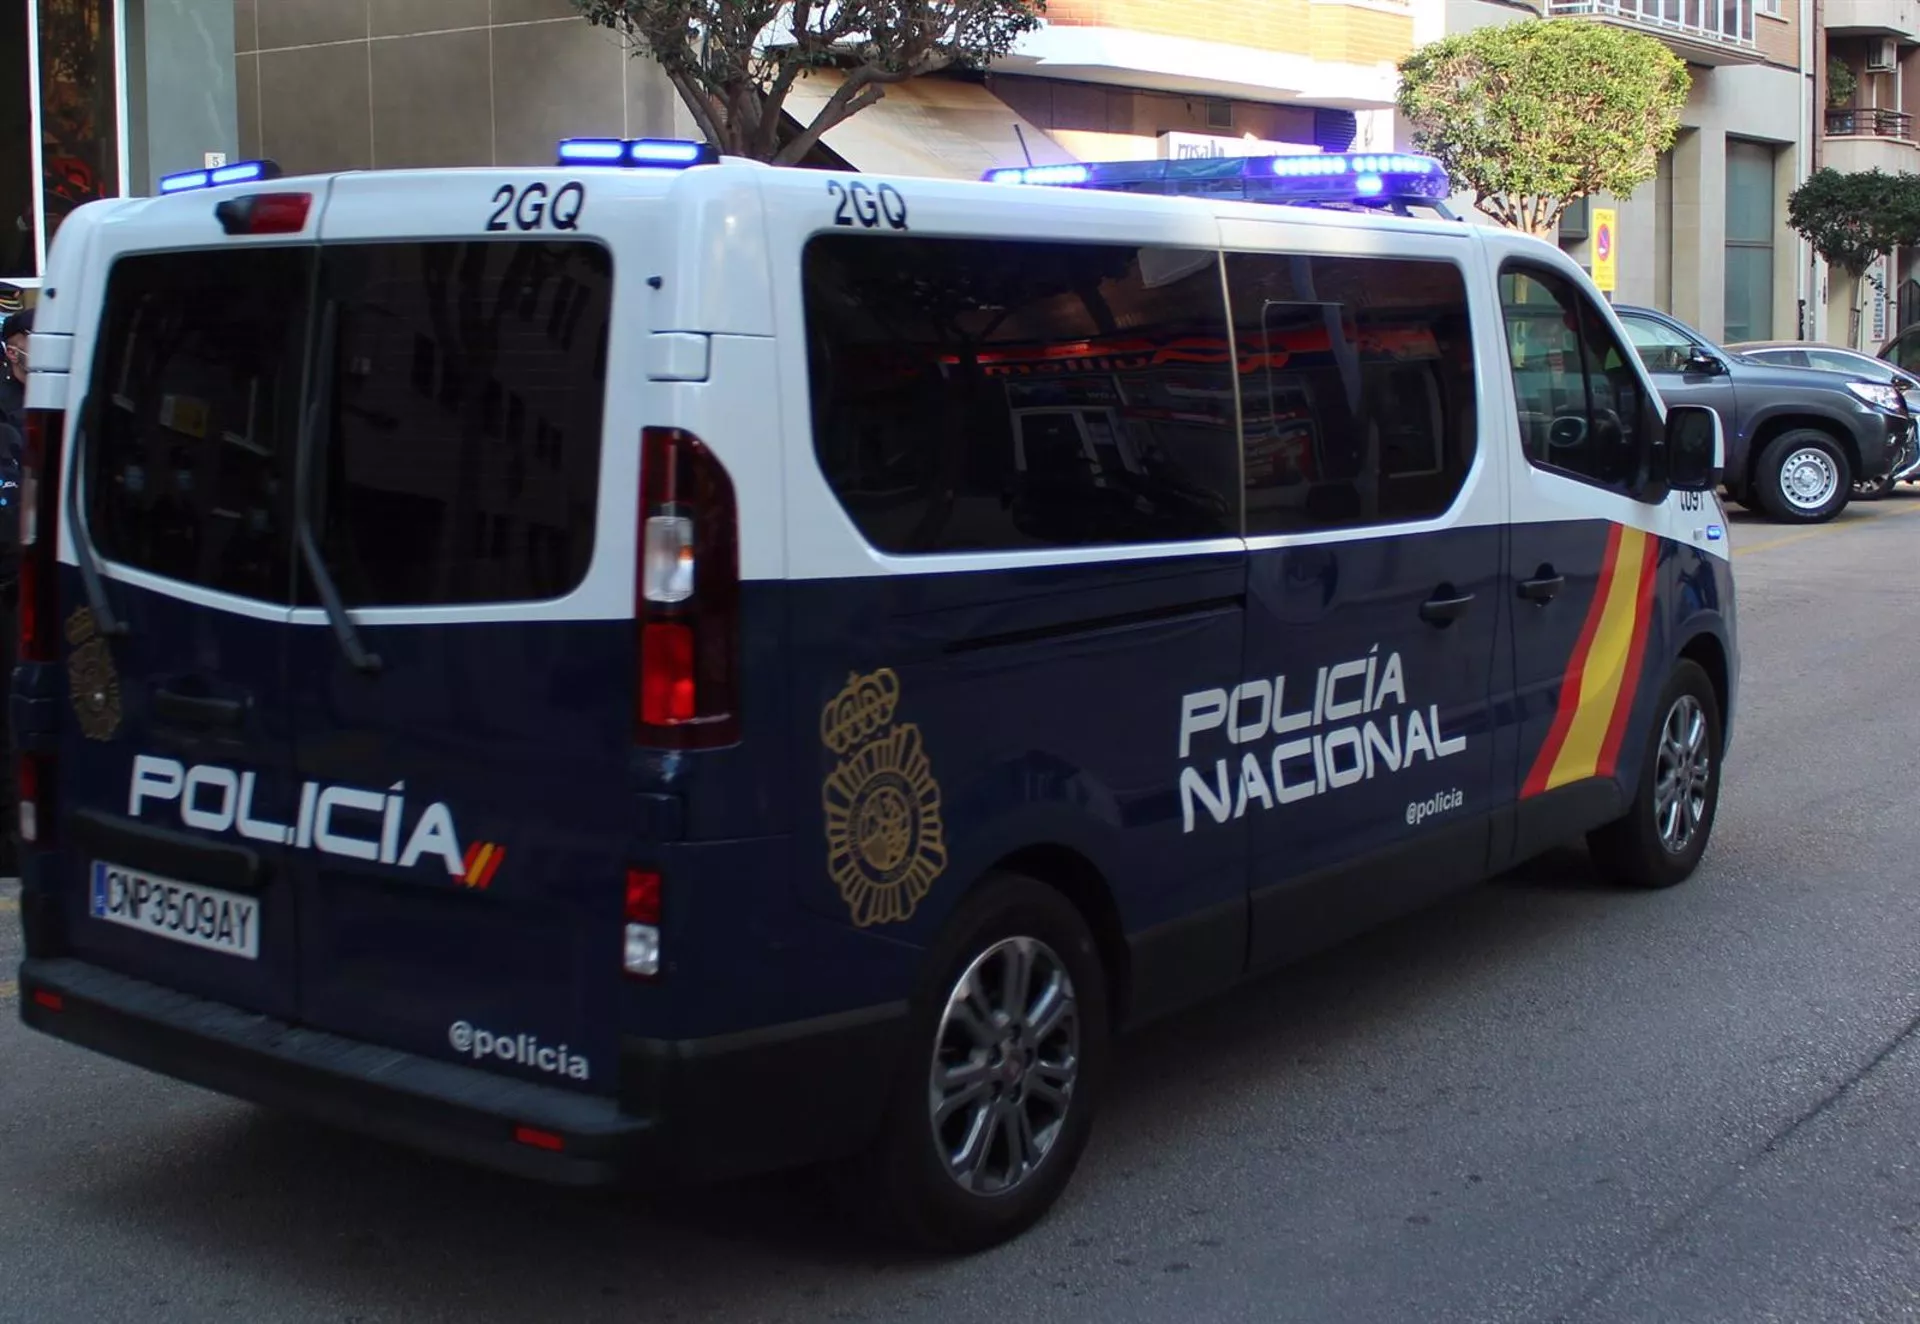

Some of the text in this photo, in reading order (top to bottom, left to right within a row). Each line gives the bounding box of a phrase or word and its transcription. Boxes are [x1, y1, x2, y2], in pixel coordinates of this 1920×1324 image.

[486, 181, 586, 231] 2GQ
[827, 179, 909, 230] 2GQ
[1179, 643, 1406, 758] POLICÍA
[1179, 704, 1467, 834] NACIONAL
[128, 754, 466, 876] POLICÍA
[1405, 788, 1463, 825] @policia
[108, 871, 252, 949] CNP3509AY
[449, 1020, 590, 1080] @policia
